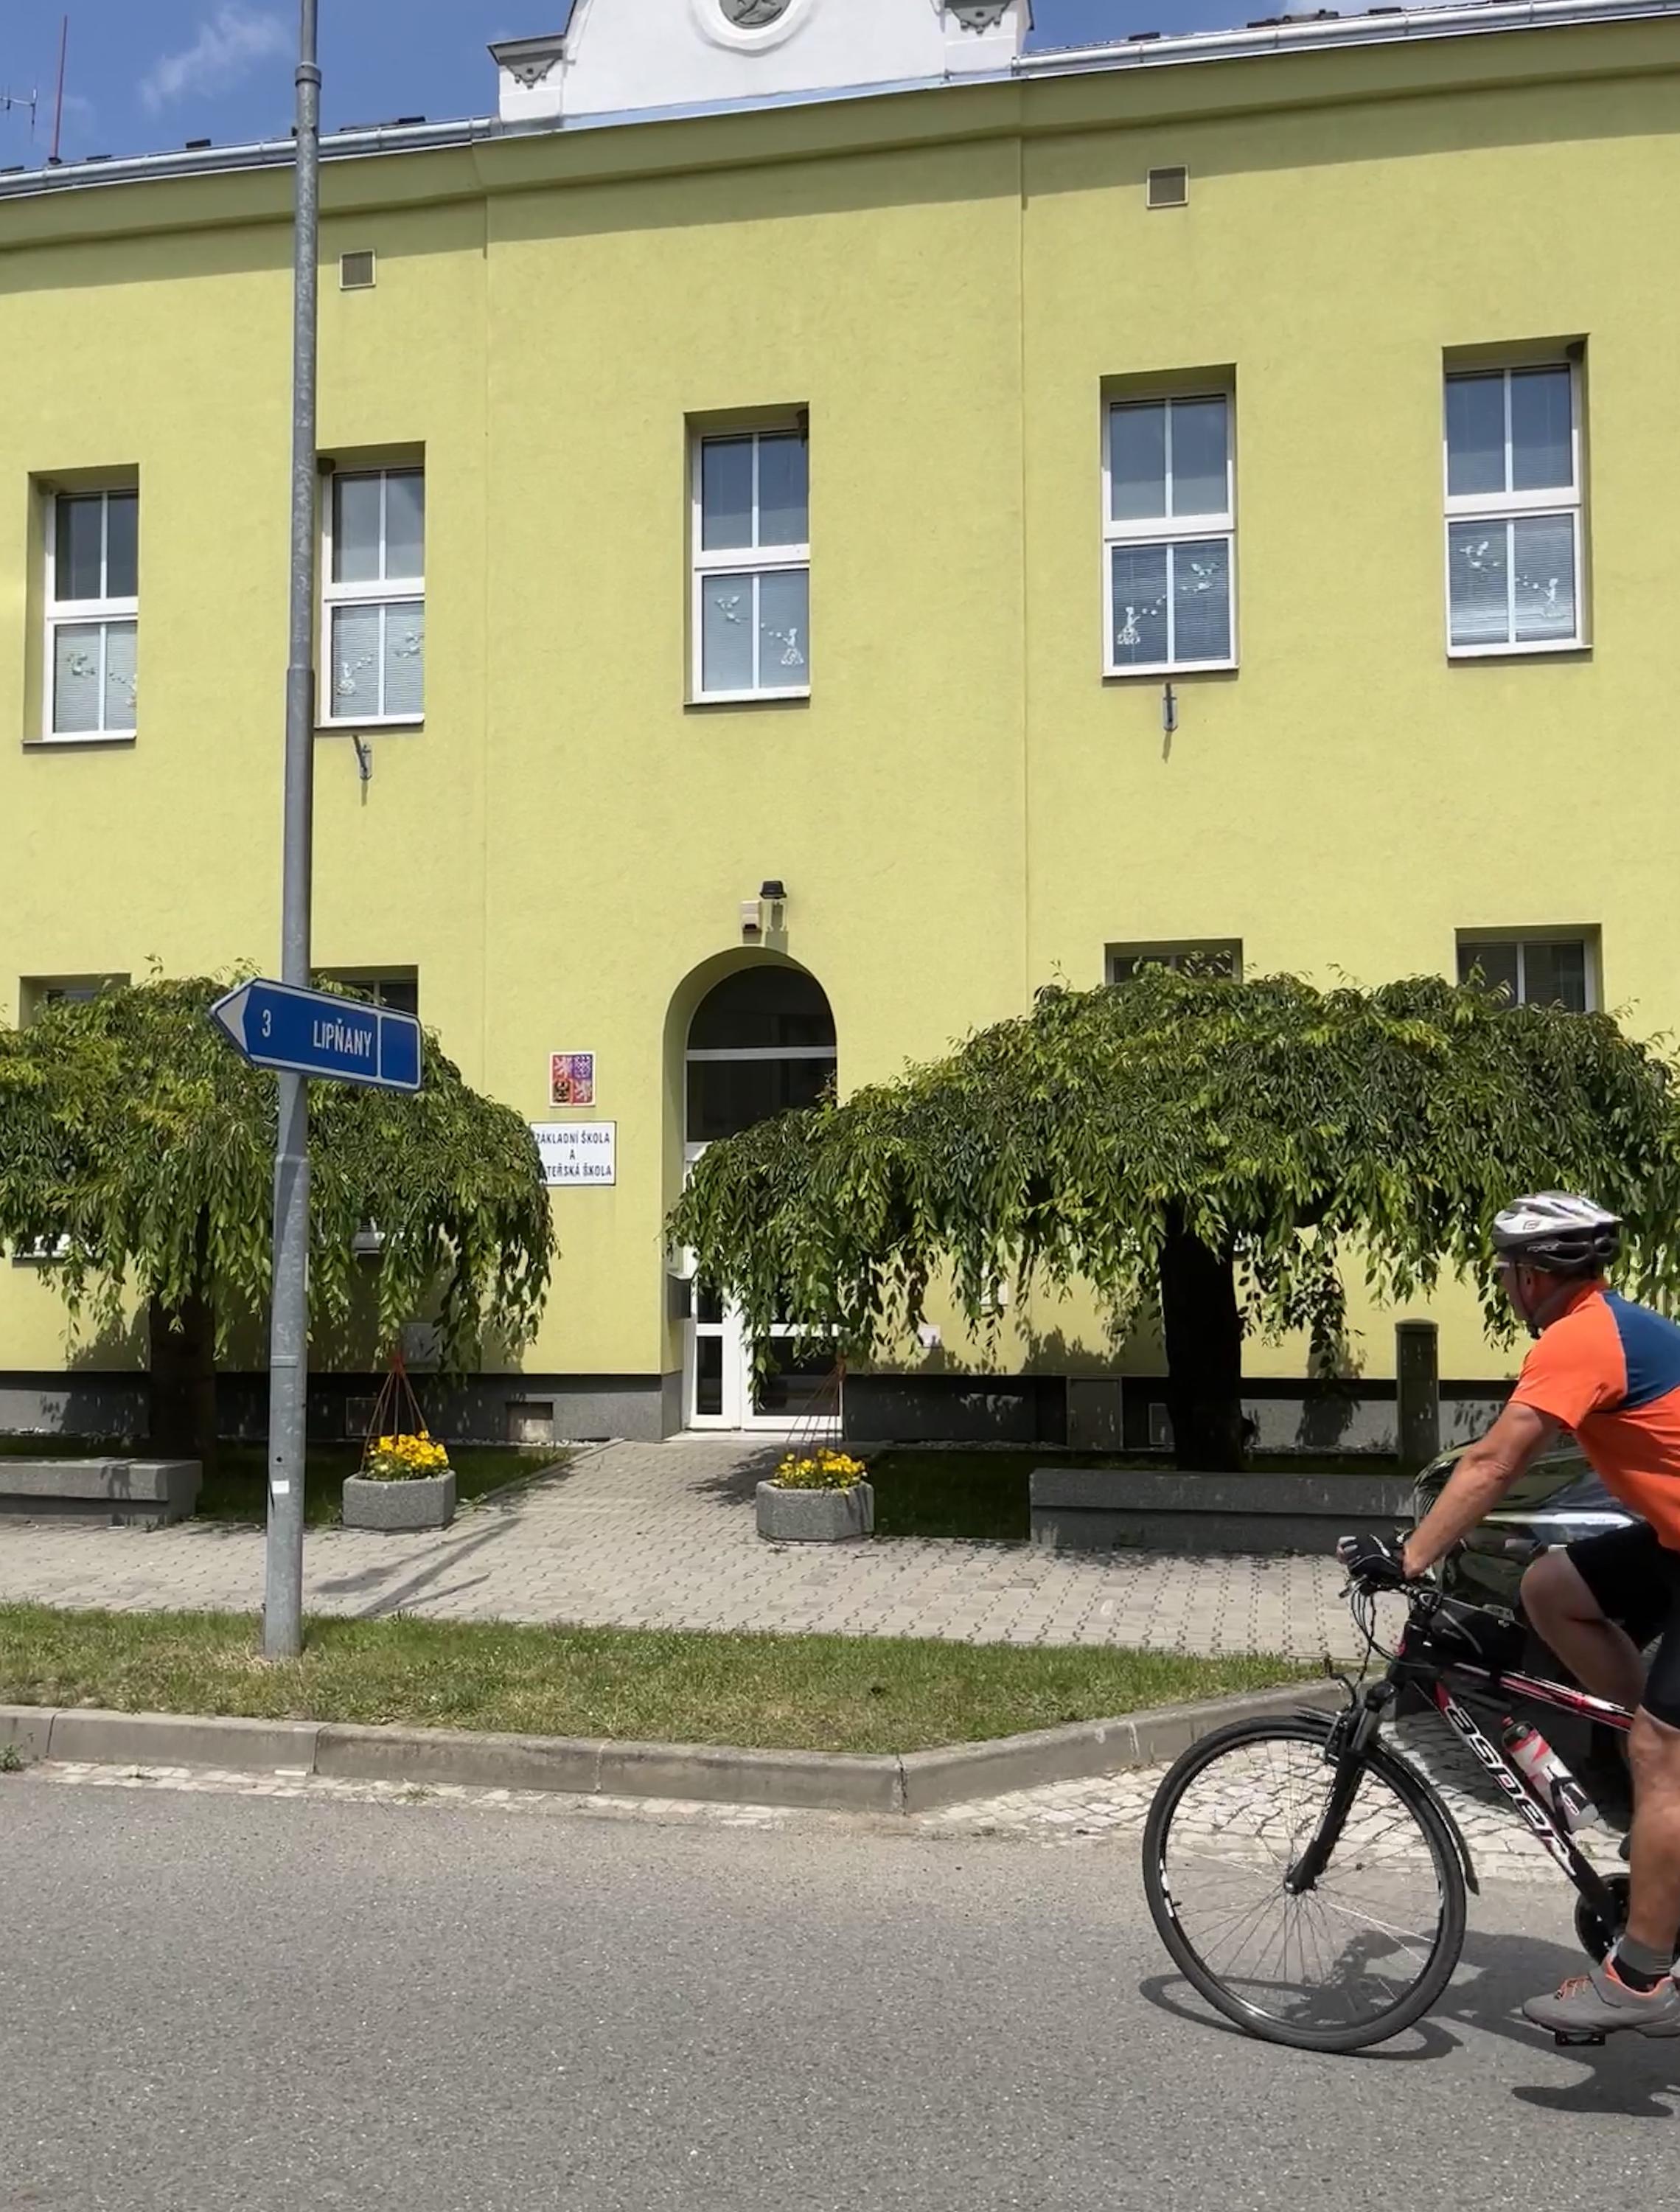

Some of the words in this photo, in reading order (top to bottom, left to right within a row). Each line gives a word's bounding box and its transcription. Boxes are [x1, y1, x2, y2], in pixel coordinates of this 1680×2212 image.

[262, 1009, 272, 1037] 3
[313, 1017, 373, 1057] LIPŇANY
[536, 1130, 578, 1144] ZÁKLADNÍ
[581, 1130, 610, 1144] ŠKOLA
[569, 1149, 576, 1161] A
[546, 1163, 580, 1177] TEŘSKÁ
[582, 1163, 612, 1177] ŠKOLA
